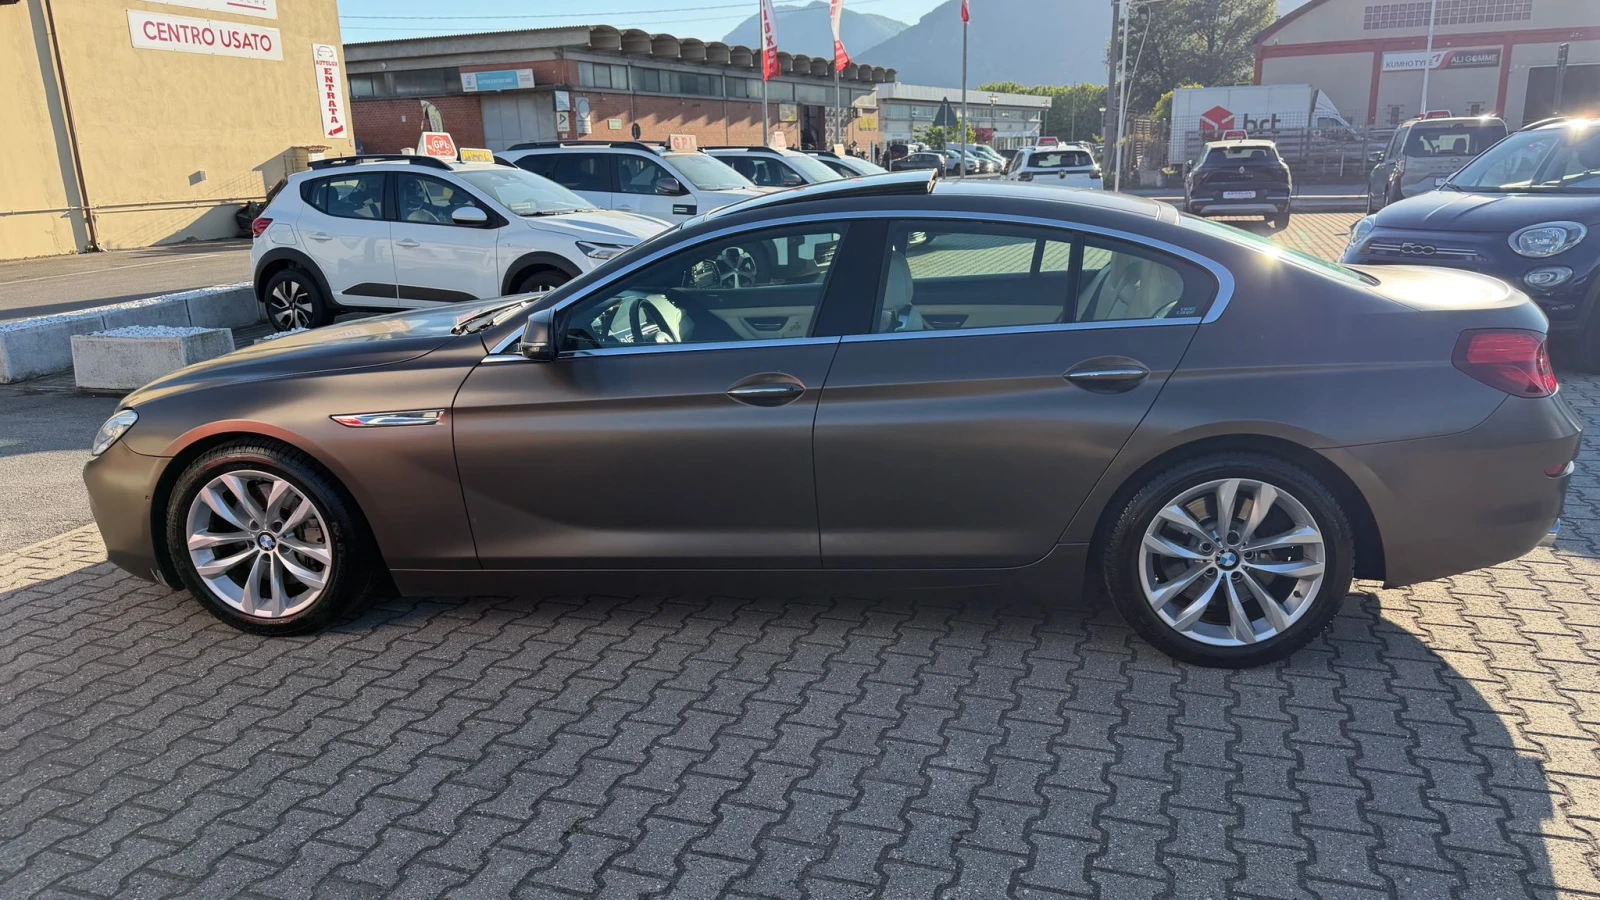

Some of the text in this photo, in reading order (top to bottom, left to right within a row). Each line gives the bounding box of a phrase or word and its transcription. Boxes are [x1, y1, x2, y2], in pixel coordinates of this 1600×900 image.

[143, 20, 272, 52] CENTRO USATO
[1385, 60, 1414, 69] KUMHO
[1465, 54, 1498, 62] GOMME
[324, 68, 339, 123] ENTRATA
[1243, 113, 1281, 135] brt
[433, 140, 450, 149] GPL
[1401, 242, 1436, 256] 500
